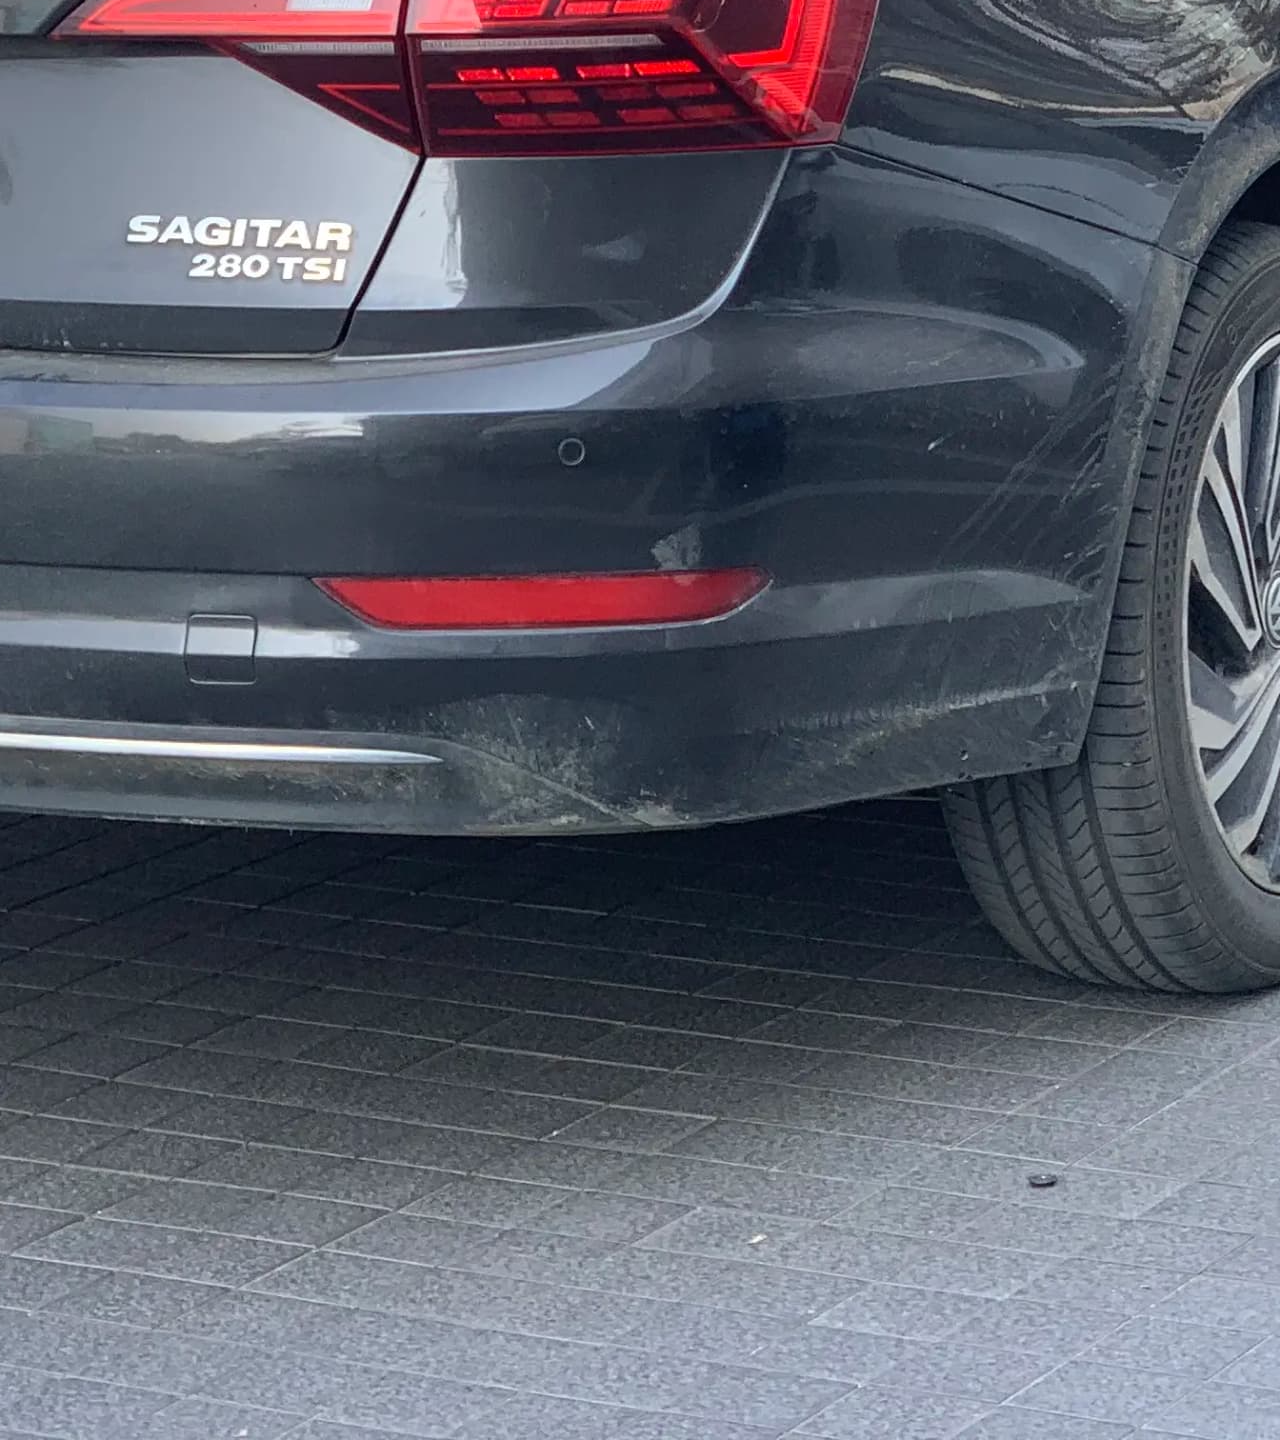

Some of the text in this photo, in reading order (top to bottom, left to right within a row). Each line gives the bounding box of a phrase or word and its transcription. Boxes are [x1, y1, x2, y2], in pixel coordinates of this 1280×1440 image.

[126, 215, 353, 251] SAGITAR
[188, 252, 347, 281] 280 TSI
